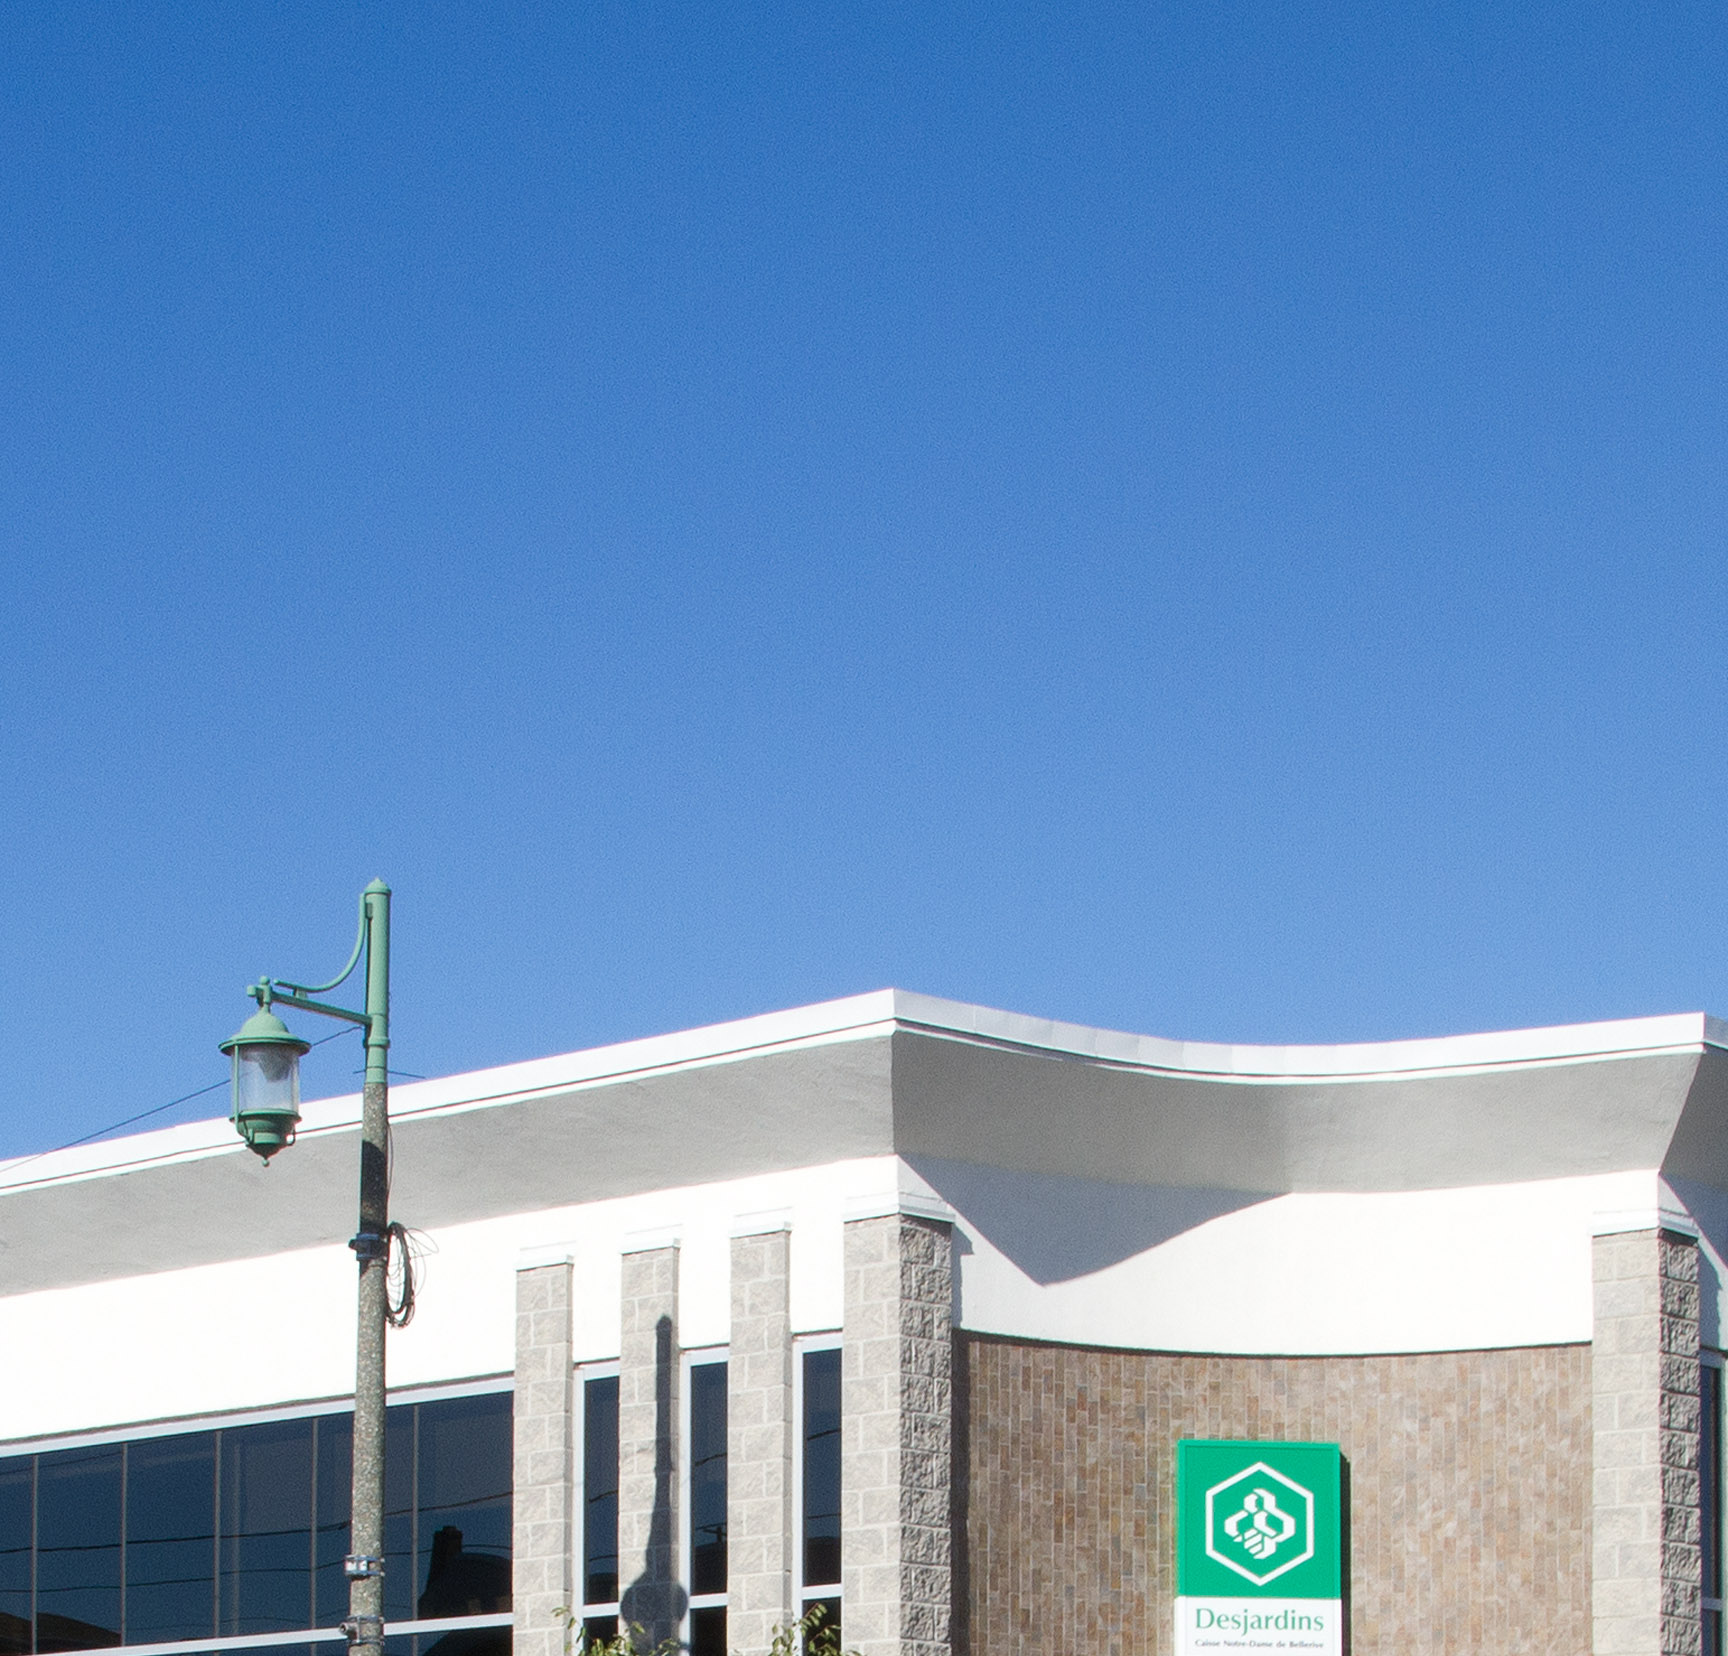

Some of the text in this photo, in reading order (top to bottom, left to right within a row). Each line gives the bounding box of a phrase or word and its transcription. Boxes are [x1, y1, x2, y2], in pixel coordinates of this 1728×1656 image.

[1196, 1608, 1324, 1636] Desjardins
[1195, 1639, 1220, 1647] Caisse
[1223, 1639, 1273, 1648] Notre-Dame
[1289, 1641, 1324, 1649] Bellerive
